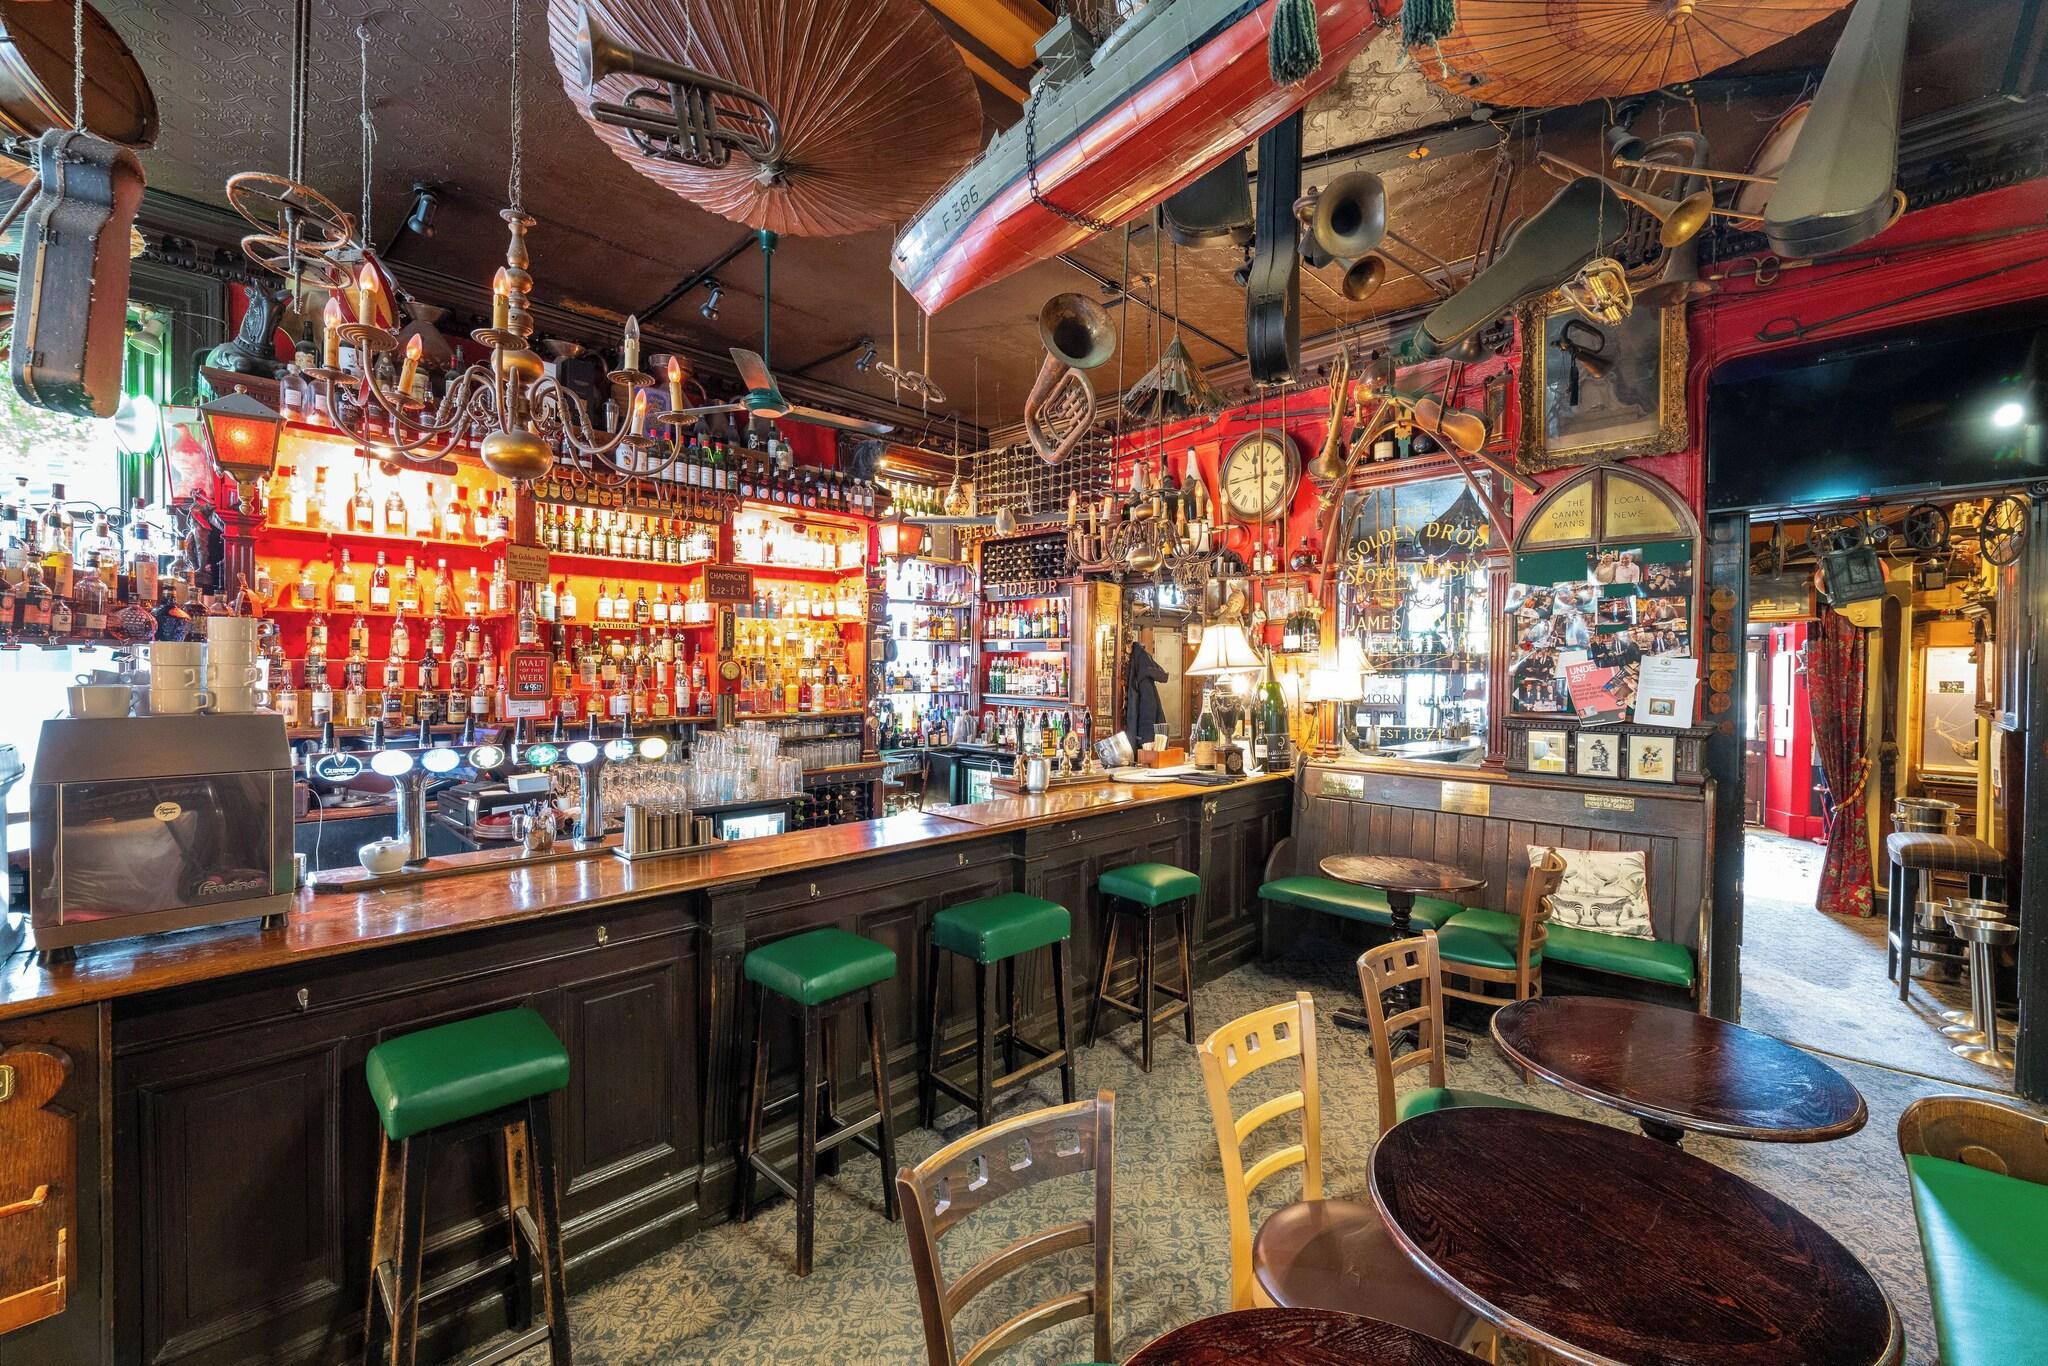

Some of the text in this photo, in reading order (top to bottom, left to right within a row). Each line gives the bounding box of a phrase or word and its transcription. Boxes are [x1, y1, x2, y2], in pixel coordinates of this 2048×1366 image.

[951, 184, 979, 222] 386
[1567, 499, 1585, 507] THE
[1614, 495, 1647, 505] LOCAL
[1552, 510, 1585, 520] CANNY
[1613, 510, 1645, 519] NEWS
[1554, 520, 1585, 529] MAN'S
[958, 525, 982, 540] THE
[1347, 522, 1486, 562] GOLDEN DROP
[710, 572, 747, 582] CHAMPAGNE
[1346, 559, 1487, 585] SCOTCH WHISKY
[998, 580, 1059, 597] LIQUEUR
[593, 622, 639, 630] MATURED
[1346, 615, 1401, 632] JAMES
[1571, 674, 1586, 683] 25?
